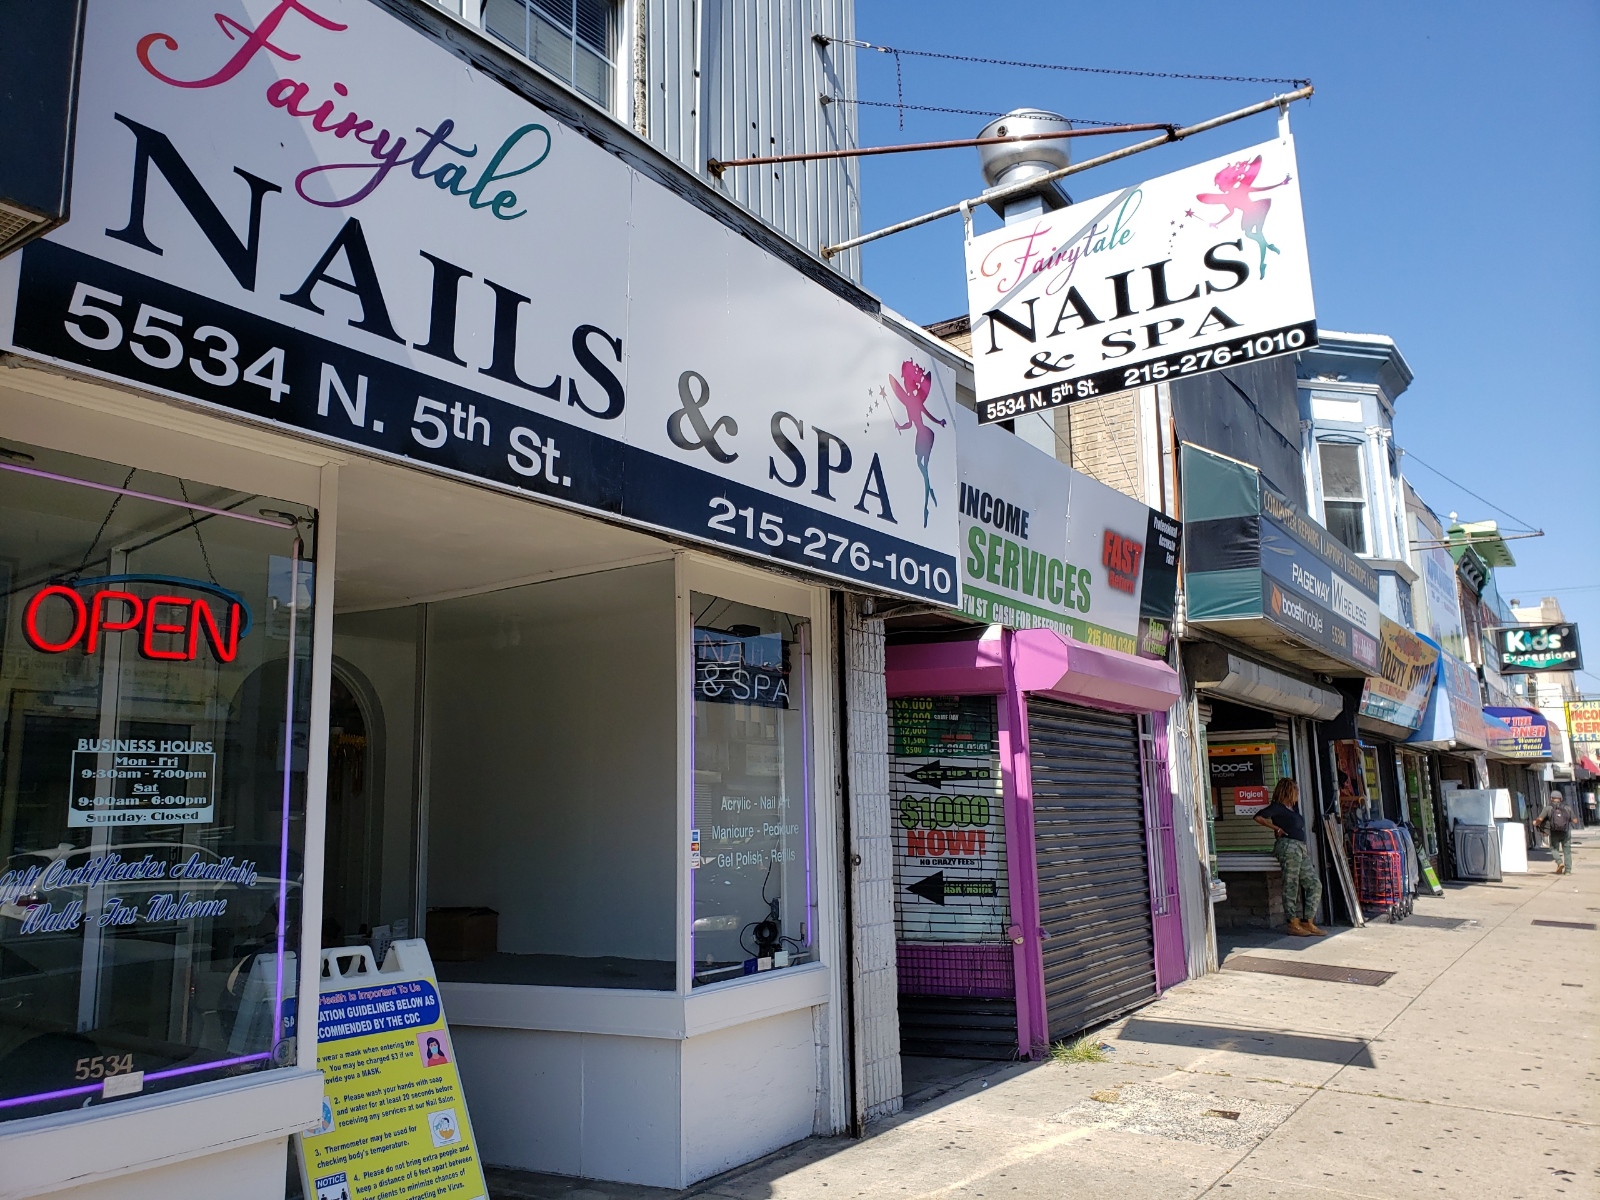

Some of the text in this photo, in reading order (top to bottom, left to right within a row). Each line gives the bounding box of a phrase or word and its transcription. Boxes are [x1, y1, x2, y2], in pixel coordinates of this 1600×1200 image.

[137, 0, 551, 220] Fairytale
[981, 189, 1143, 296] Fairytale
[982, 238, 1250, 355] NAILS
[105, 112, 897, 524] NAILS & SPA
[1024, 306, 1244, 379] & SPA
[1124, 328, 1305, 387] 215-276-1010
[64, 281, 572, 487] 5534 N. 5th St.
[987, 379, 1099, 420] 5534 N. 5th St.
[959, 481, 1030, 540] INCOME
[1263, 490, 1297, 533] COMPUTER
[1298, 518, 1320, 550] REPAIRS
[1323, 540, 1344, 568] LAPTOPS
[707, 497, 951, 594] 215-276-1010
[1102, 529, 1143, 577] FAST
[967, 525, 1092, 613] SERVICES
[1108, 570, 1136, 594] Return
[1292, 562, 1331, 602] PAGEWAY
[24, 585, 240, 663] OPEN
[992, 602, 1014, 627] CASH
[1016, 610, 1031, 630] FOR
[1503, 650, 1577, 665] Expressions
[702, 663, 790, 704] & SPA
[1511, 715, 1532, 726] THE
[1570, 709, 1600, 721] INCO
[77, 738, 213, 752] BUSINESS HOURS
[905, 746, 922, 754] $500
[81, 769, 207, 780] 9:30am 7:00pm
[115, 756, 179, 766] Mon Fri
[969, 770, 989, 778] TO
[1211, 761, 1254, 773] boost
[78, 795, 207, 806] 9:00am 6:00pm
[133, 783, 159, 792] Sat
[1239, 790, 1263, 799] Digicel
[85, 811, 199, 823] Sunday: Closed
[721, 796, 752, 814] Acrylic
[760, 796, 776, 810] Nail
[900, 794, 990, 830] $1,000
[711, 822, 799, 839] Manicure Pedicure
[907, 829, 986, 856] NOW!
[717, 848, 796, 868] Gel Polish Refills
[931, 858, 956, 866] CRAZY
[958, 858, 975, 866] FEES
[0, 864, 43, 904] Gift
[42, 852, 166, 891] Certificates
[169, 852, 258, 886] Available
[20, 891, 228, 935] Walk Ins Welcome
[347, 995, 435, 1018] GUIDELINES BELOW AS
[373, 1012, 421, 1029] BY THE CDC
[345, 1041, 405, 1057] mask when entering
[75, 1053, 134, 1080] 5534
[329, 1064, 342, 1072] You
[342, 1062, 356, 1070] may
[366, 1055, 390, 1065] charged
[361, 1067, 382, 1077] MASK.
[336, 1085, 453, 1116] and water least seconds before
[343, 1078, 429, 1103] Please wash your hands with
[338, 1099, 438, 1128] receiving any services Nail
[324, 1127, 408, 1154] Thermometer may used
[317, 1140, 410, 1169] checking body's temperature.
[363, 1144, 470, 1179] Please bring extra people and
[317, 1173, 345, 1189] NOTICE
[355, 1156, 473, 1195] keep distance feet apart between
[407, 1179, 434, 1192] minimize
[434, 1173, 459, 1184] chances
